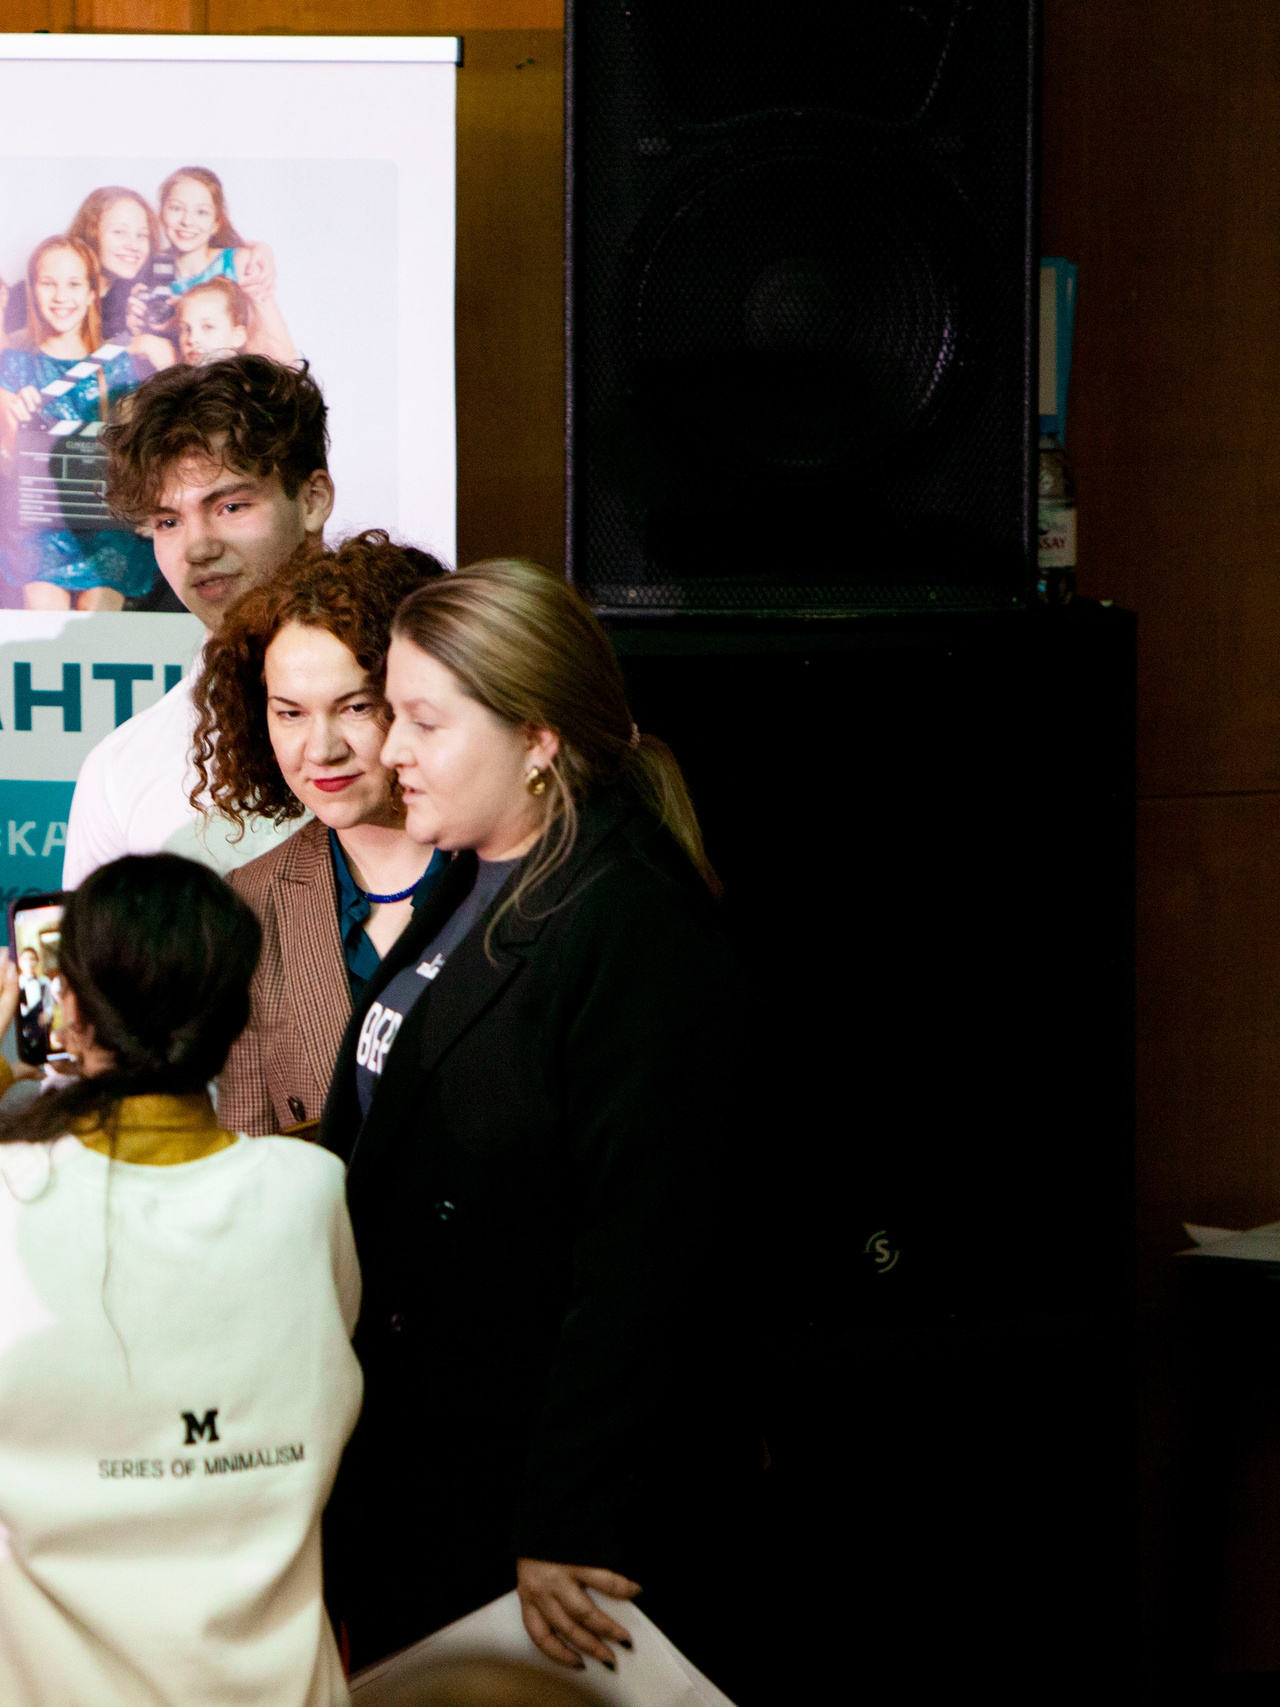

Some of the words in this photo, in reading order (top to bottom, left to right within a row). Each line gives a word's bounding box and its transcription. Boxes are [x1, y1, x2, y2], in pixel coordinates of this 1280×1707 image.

[181, 1408, 219, 1445] M
[98, 1458, 165, 1480] SERIES
[170, 1458, 195, 1479] OF
[204, 1443, 304, 1475] MINIMALISM
